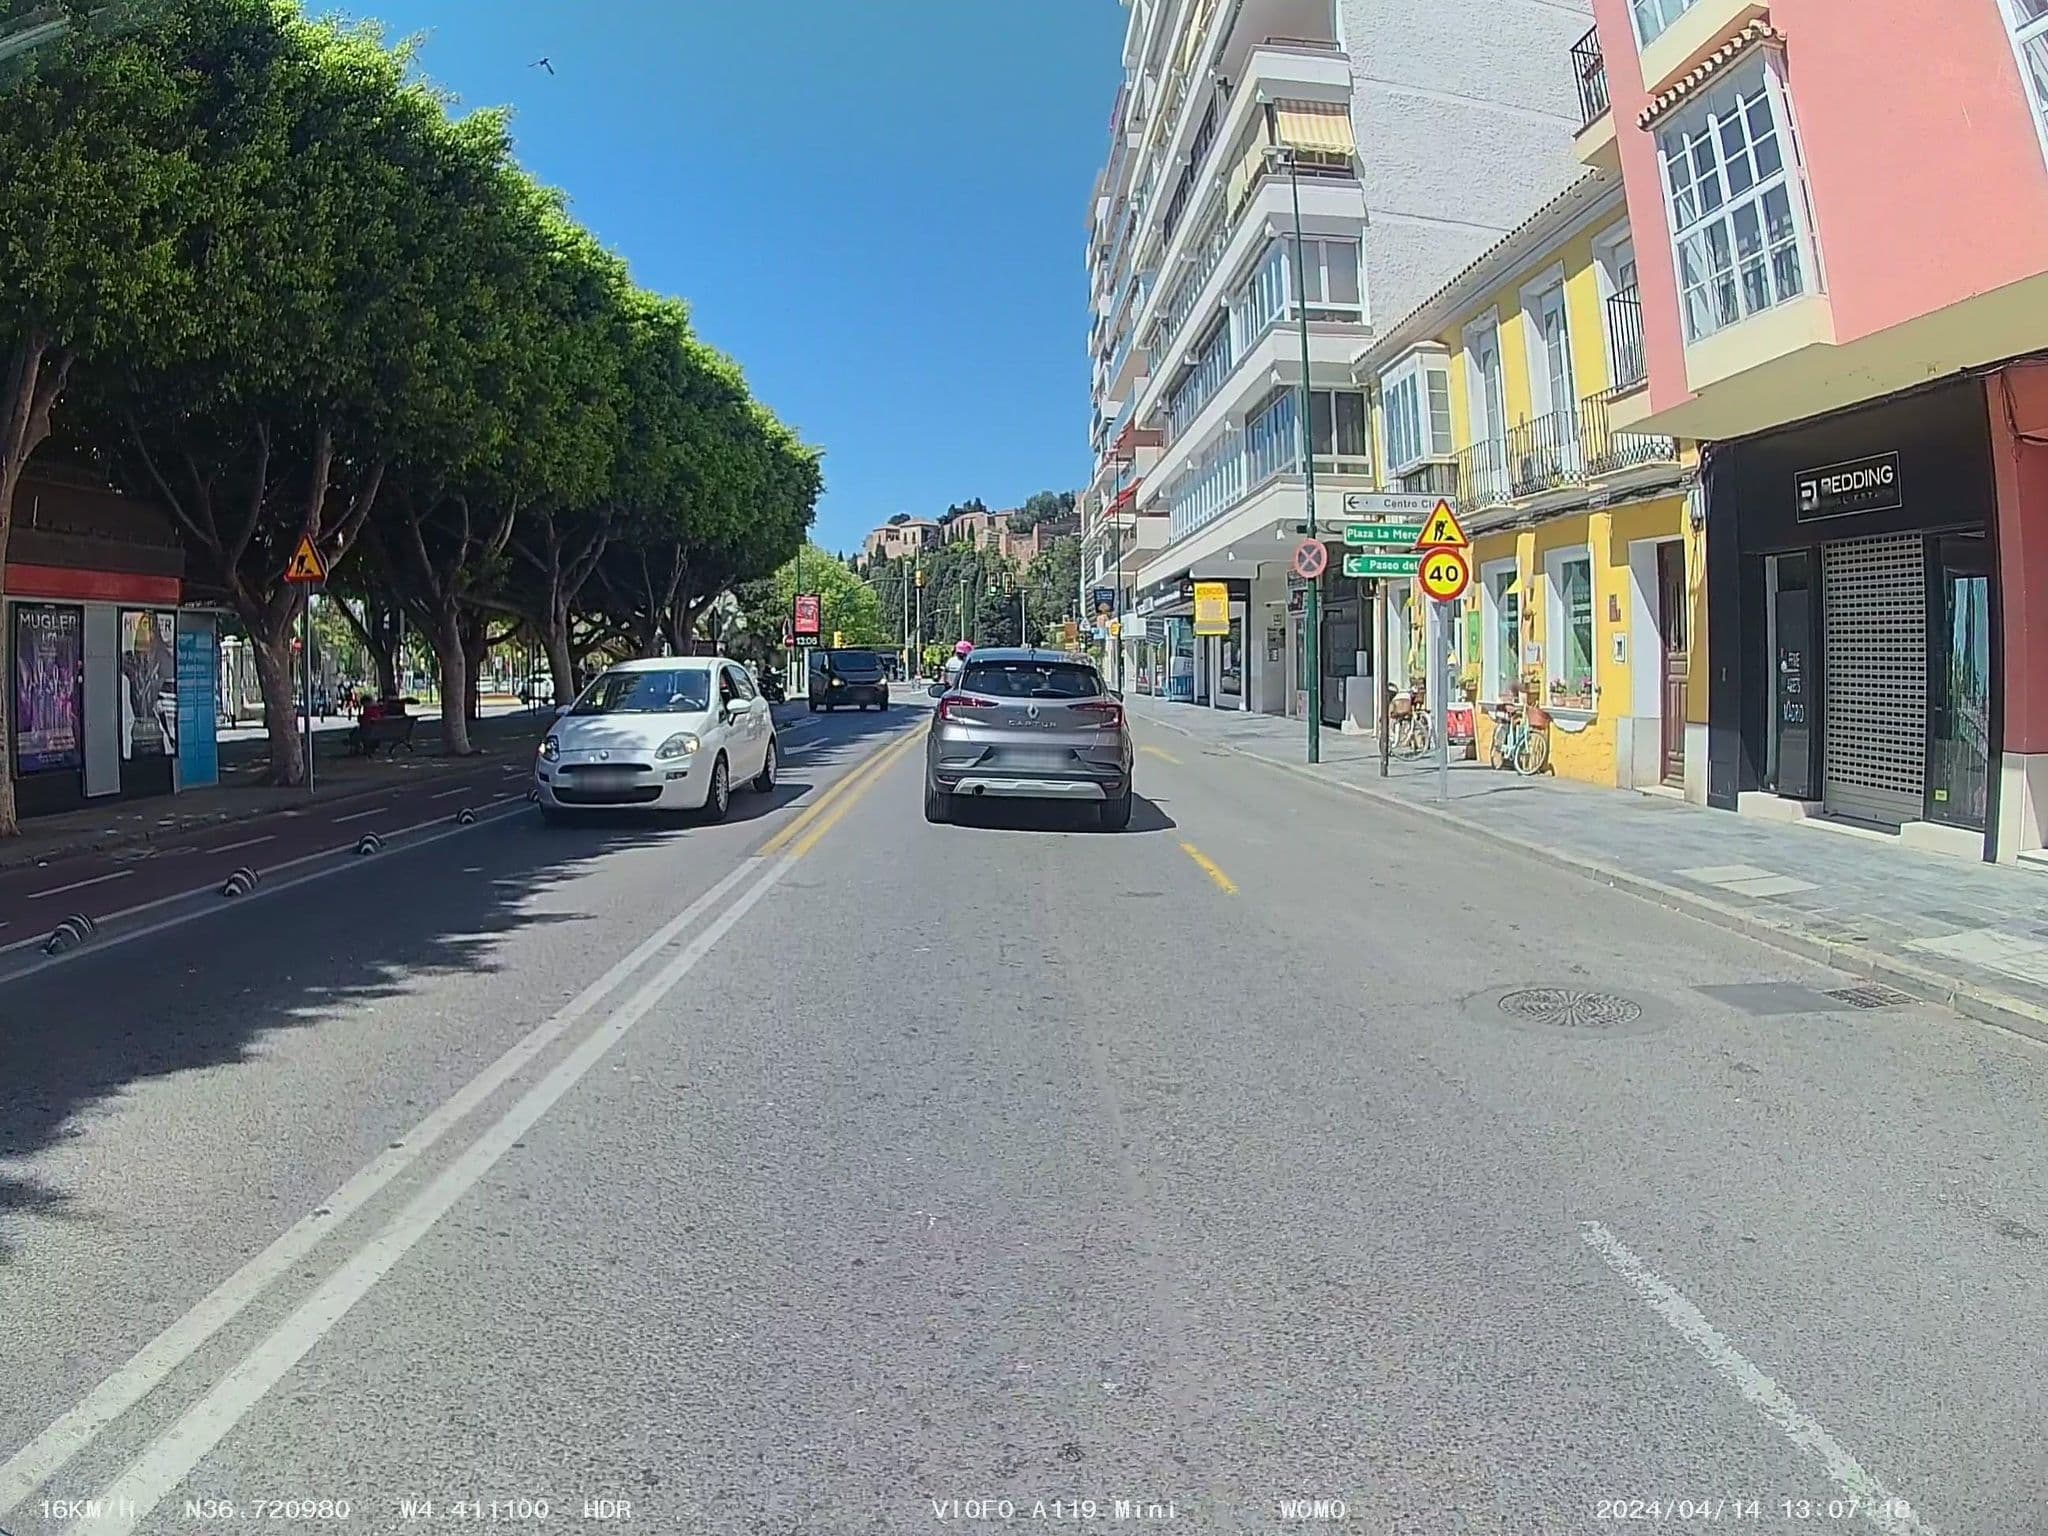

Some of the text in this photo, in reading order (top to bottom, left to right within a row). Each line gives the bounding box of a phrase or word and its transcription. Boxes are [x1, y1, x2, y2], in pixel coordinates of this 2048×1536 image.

[1383, 499, 1418, 509] Centro
[1347, 529, 1419, 540] Plaza La Merc
[1369, 559, 1400, 570] Paseo
[1429, 565, 1459, 582] 40
[20, 613, 77, 631] MUGLER
